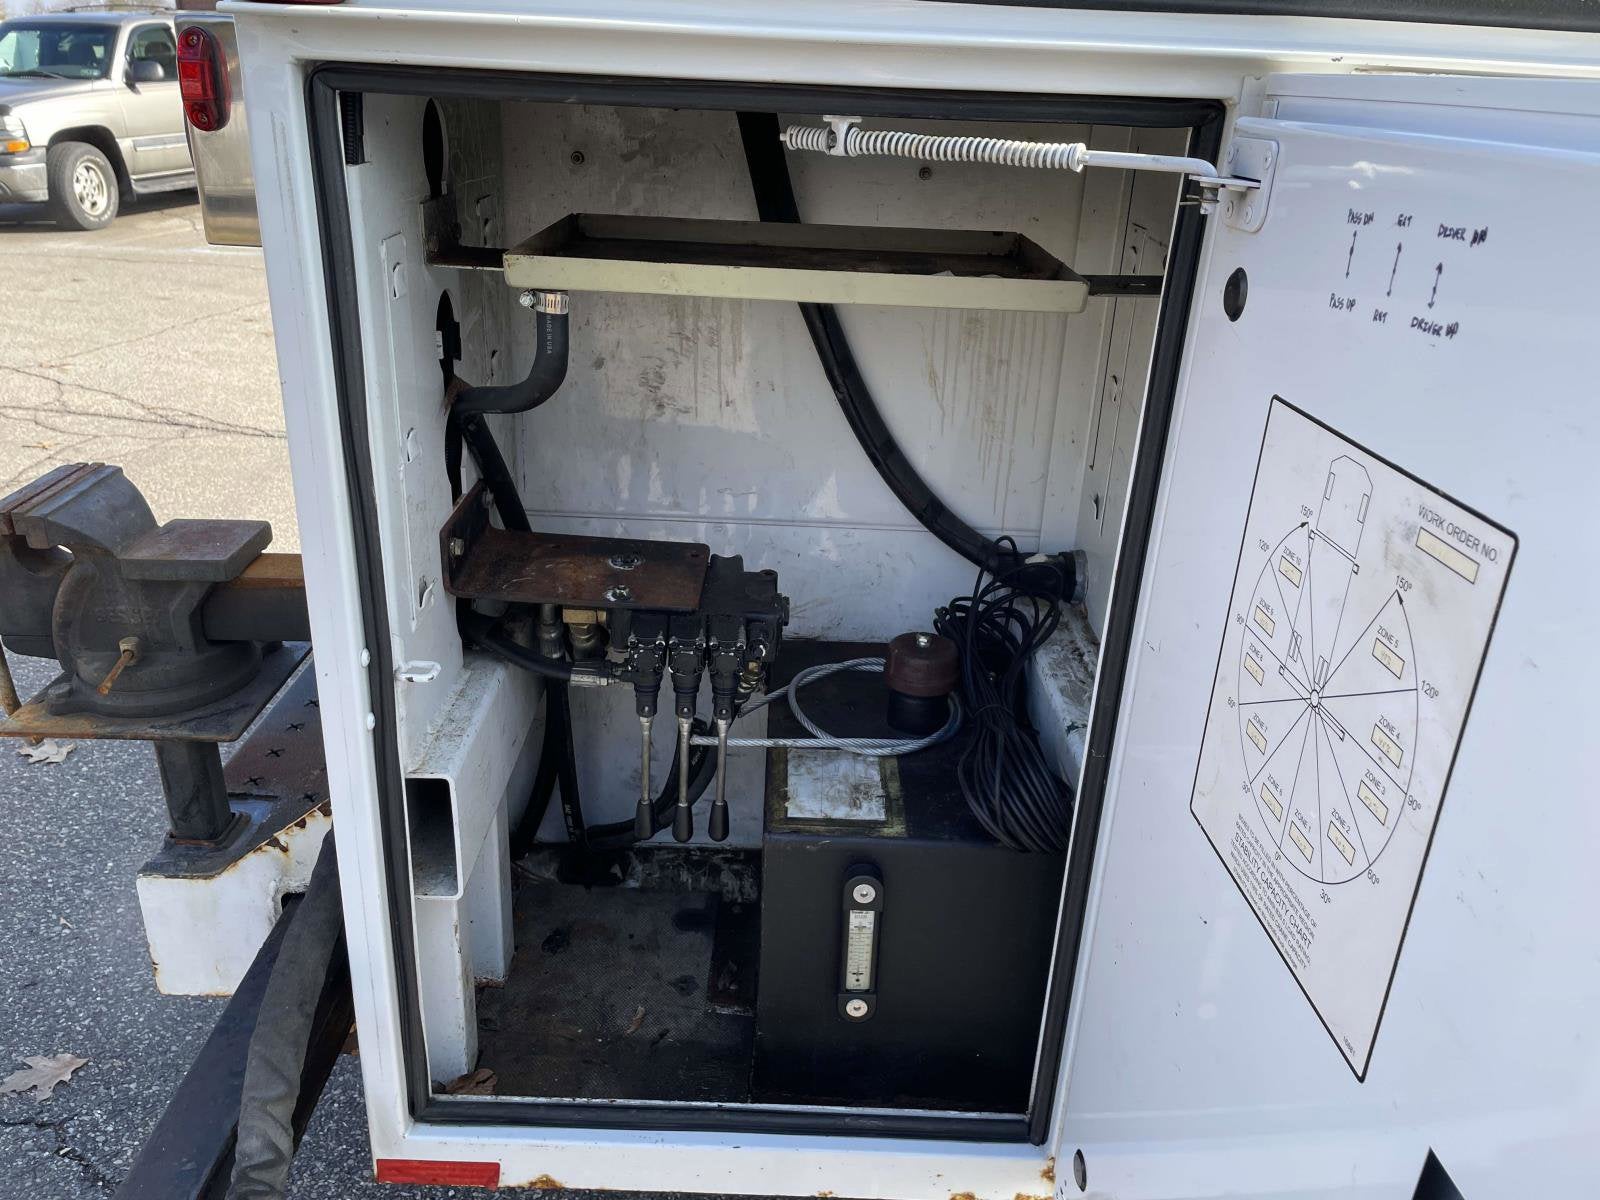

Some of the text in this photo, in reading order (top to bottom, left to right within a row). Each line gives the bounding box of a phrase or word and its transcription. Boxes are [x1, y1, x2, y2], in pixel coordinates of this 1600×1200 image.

[1417, 504, 1500, 565] WORK ORDER NO.
[1377, 624, 1393, 644] ZONE
[1378, 713, 1395, 736] ZONE
[1364, 767, 1381, 791] ZONE
[1331, 807, 1345, 829] ZONE
[1234, 831, 1311, 951] STABILITY CAPACITY CHART
